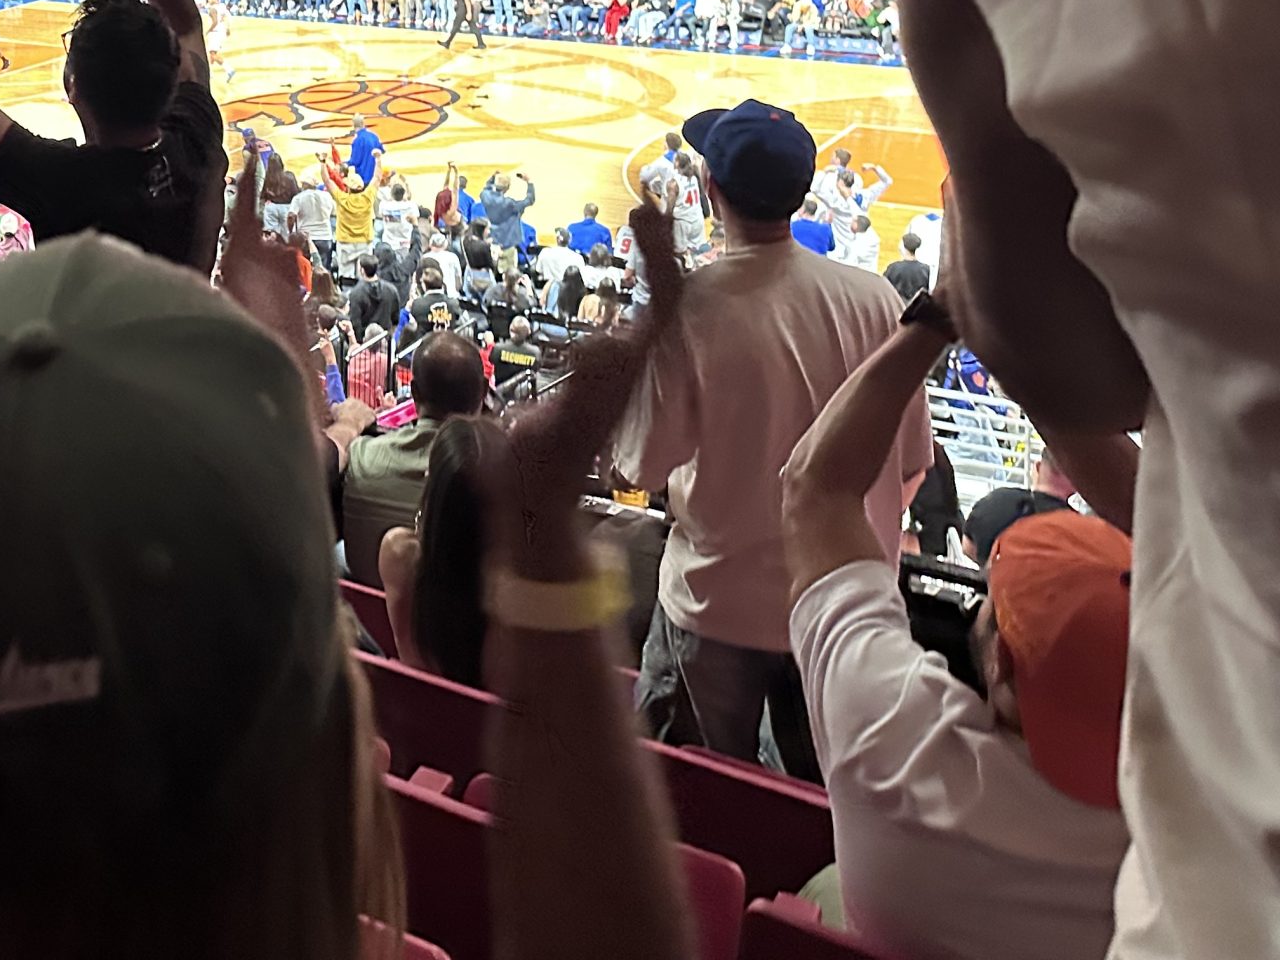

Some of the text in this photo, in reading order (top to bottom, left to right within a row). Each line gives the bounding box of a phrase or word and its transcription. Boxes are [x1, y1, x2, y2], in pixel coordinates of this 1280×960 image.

[684, 189, 699, 206] 41
[620, 238, 632, 254] 9
[500, 350, 535, 366] SECURITY
